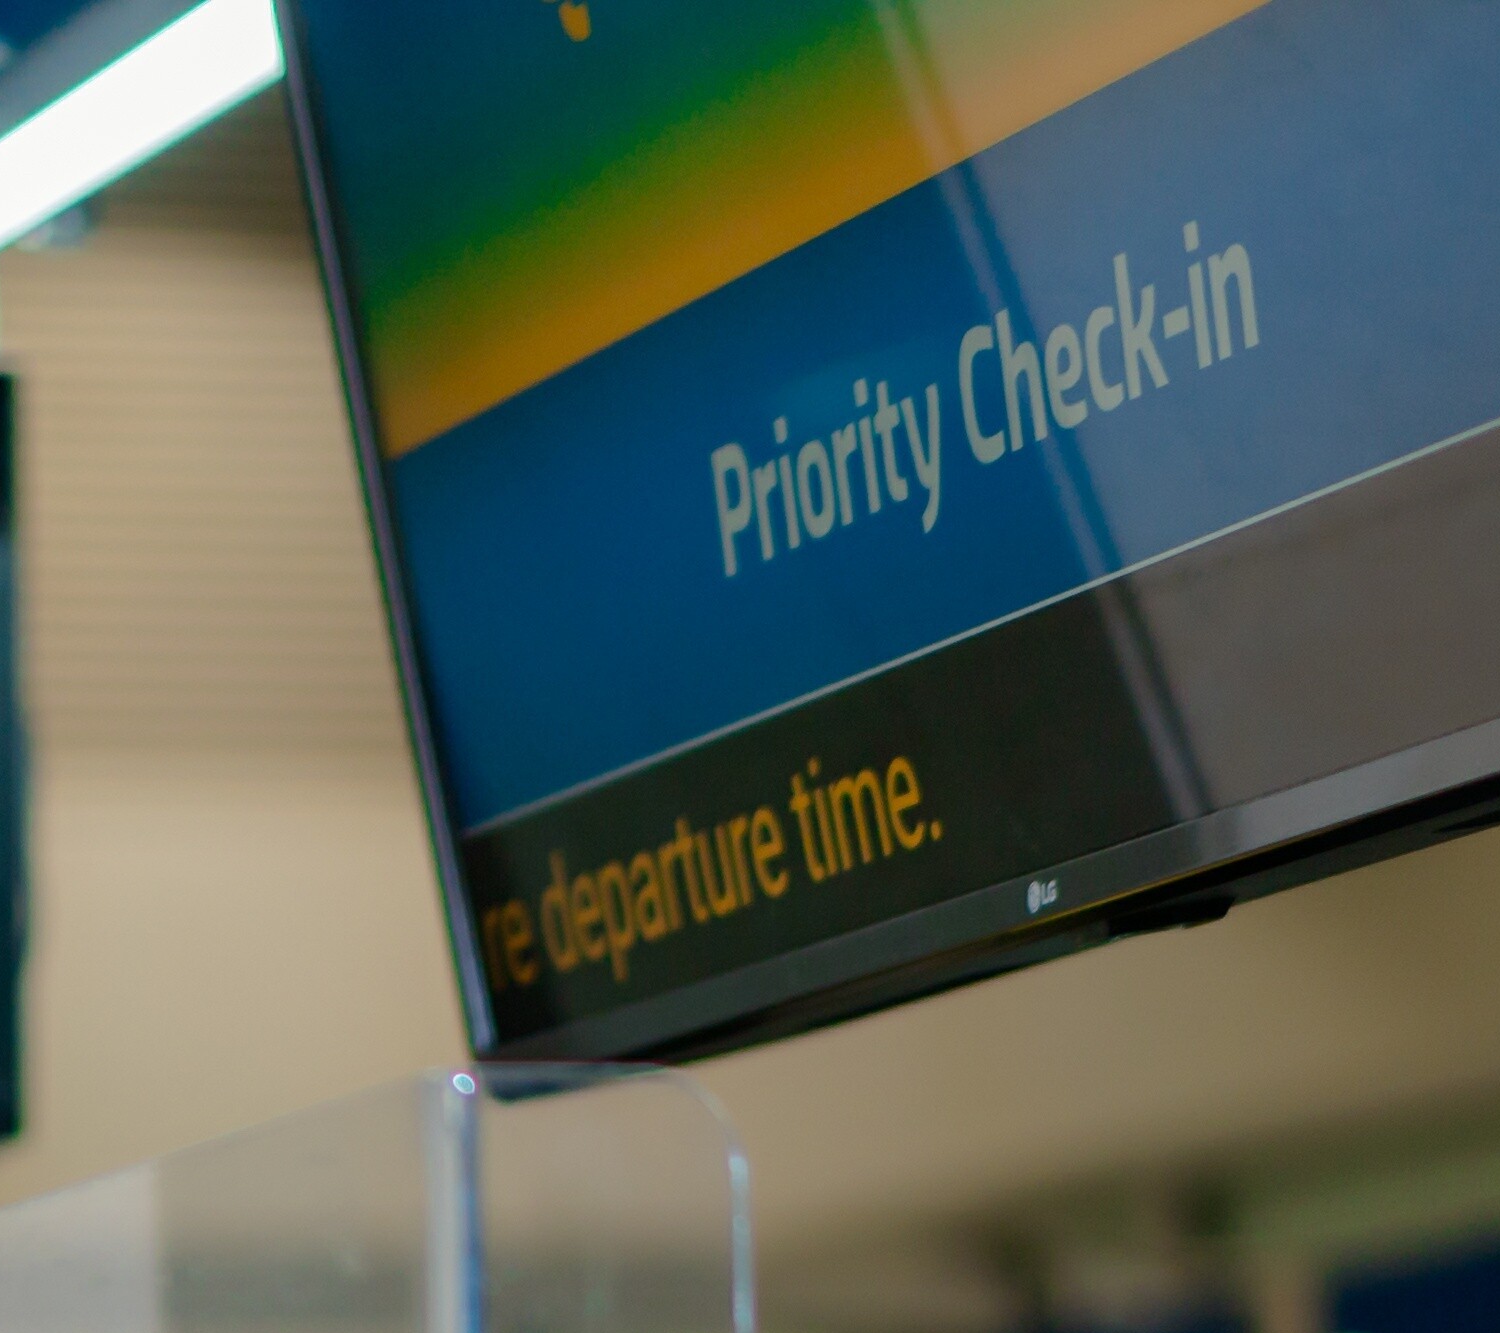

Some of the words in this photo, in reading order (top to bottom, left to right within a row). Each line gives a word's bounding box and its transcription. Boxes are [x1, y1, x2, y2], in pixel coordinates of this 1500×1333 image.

[711, 378, 940, 578] Priority
[958, 220, 1260, 465] Check-in
[540, 805, 789, 982] departure
[789, 755, 943, 883] time.
